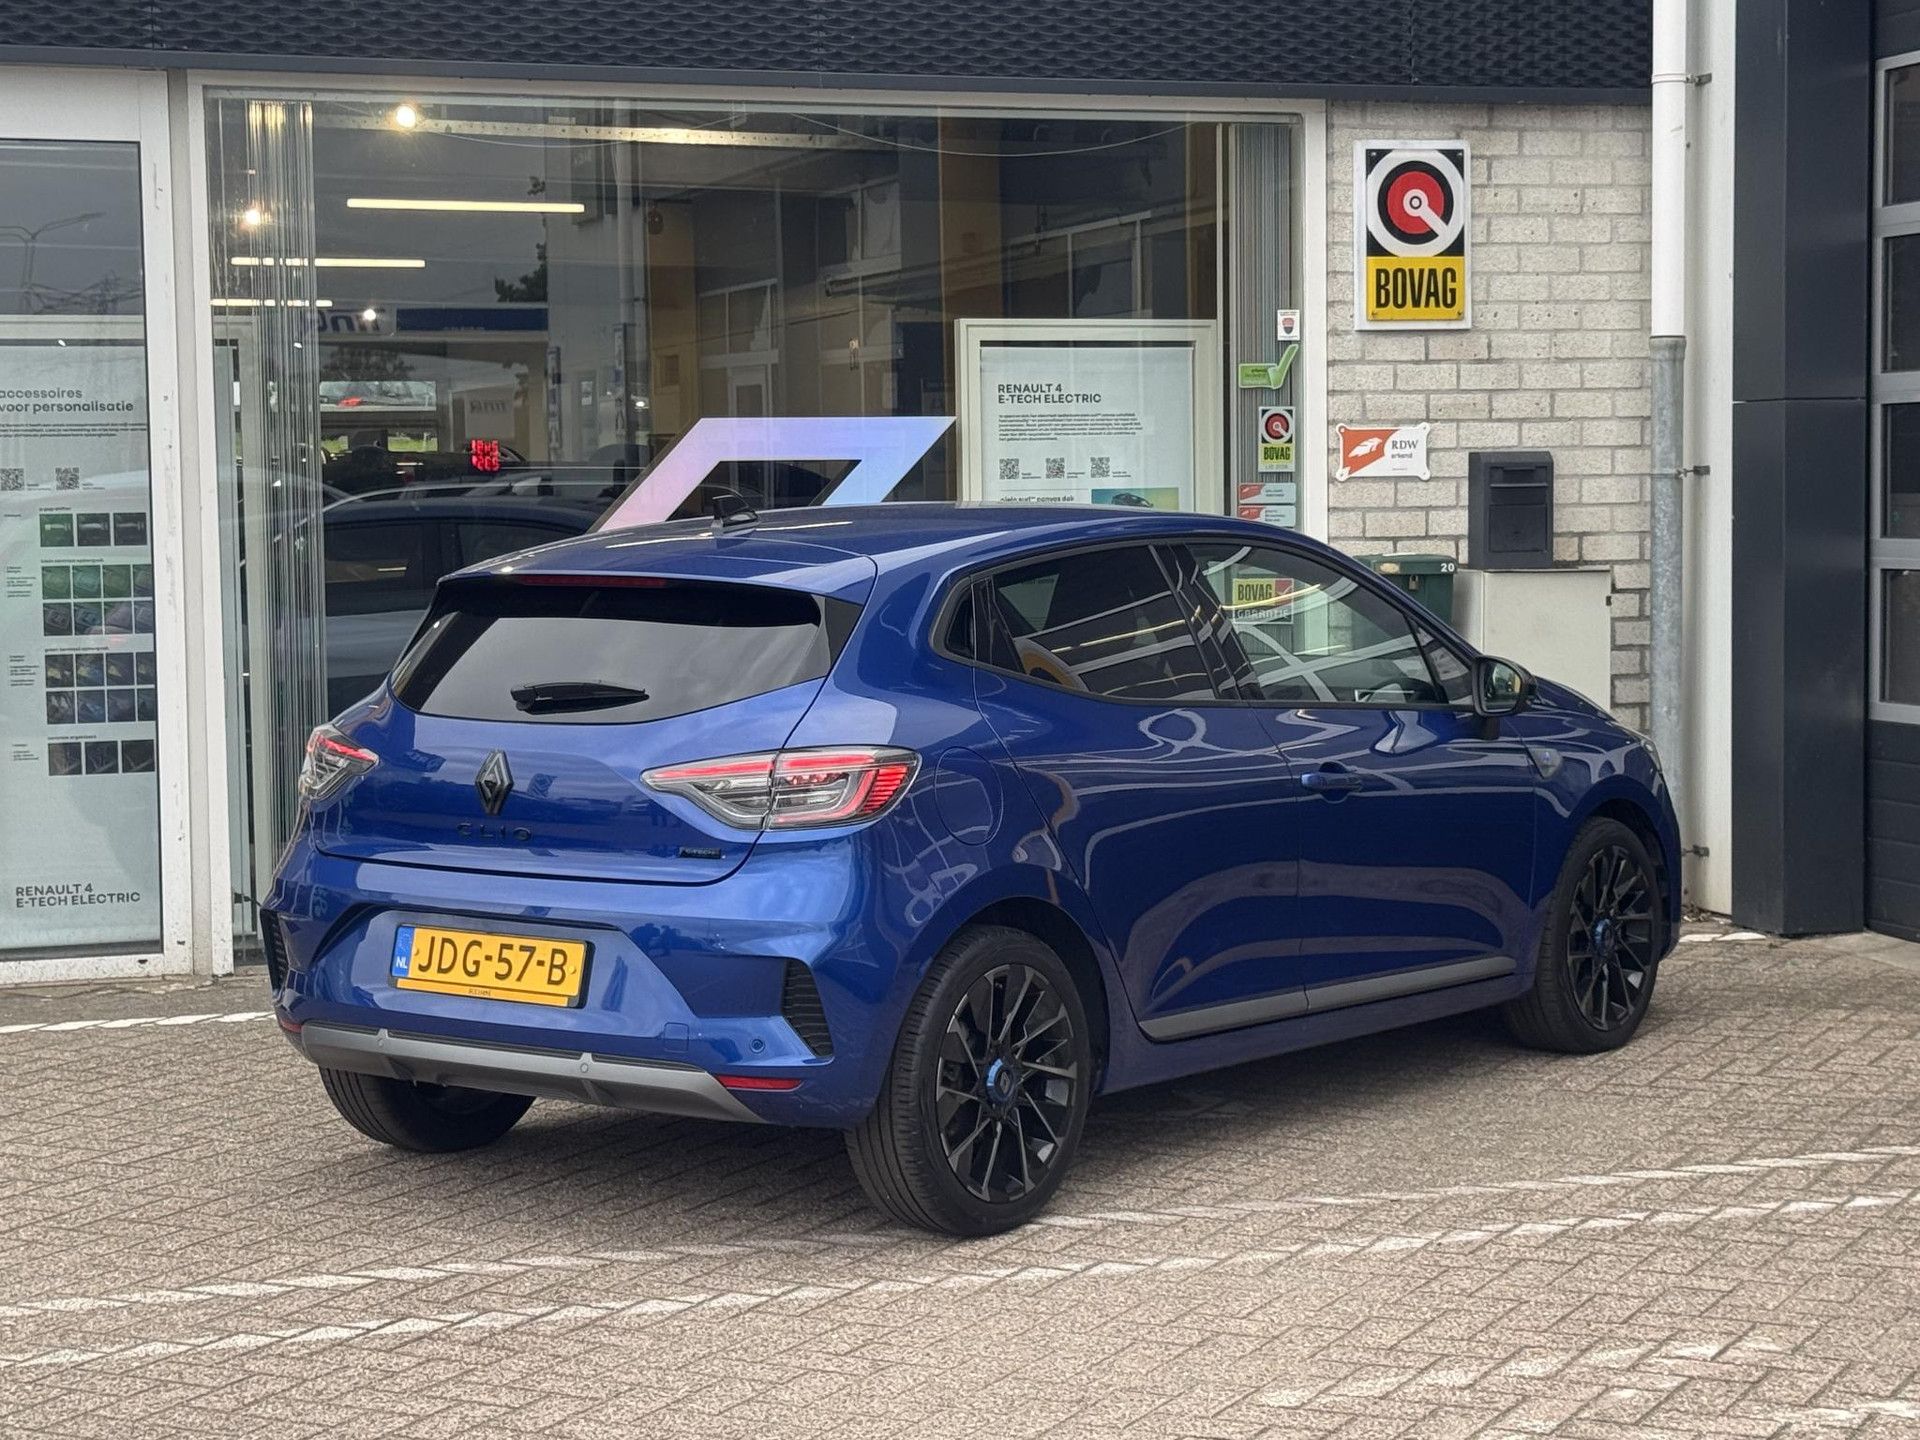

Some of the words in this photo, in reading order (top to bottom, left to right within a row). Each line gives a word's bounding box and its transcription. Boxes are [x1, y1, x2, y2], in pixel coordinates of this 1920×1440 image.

[1375, 267, 1457, 308] BOVAG
[0, 387, 83, 399] accessoires
[998, 384, 1053, 394] RENAULT
[1054, 384, 1063, 393] 4
[998, 394, 1042, 404] E-TECH
[1044, 393, 1102, 404] ELECTRIC
[0, 403, 30, 413] voor
[33, 400, 134, 414] personalisatie
[1391, 440, 1419, 450] RDW
[1263, 446, 1291, 461] BOVAG
[1441, 563, 1455, 573] 20
[1238, 584, 1273, 601] BOVAG
[456, 822, 532, 841] CLIO
[16, 884, 82, 896] RENAULT
[84, 883, 93, 893] 4
[16, 896, 68, 908] E-TECH
[70, 892, 140, 905] ELECTRIC
[396, 956, 408, 969] NL
[418, 936, 568, 986] JDG-57-B
